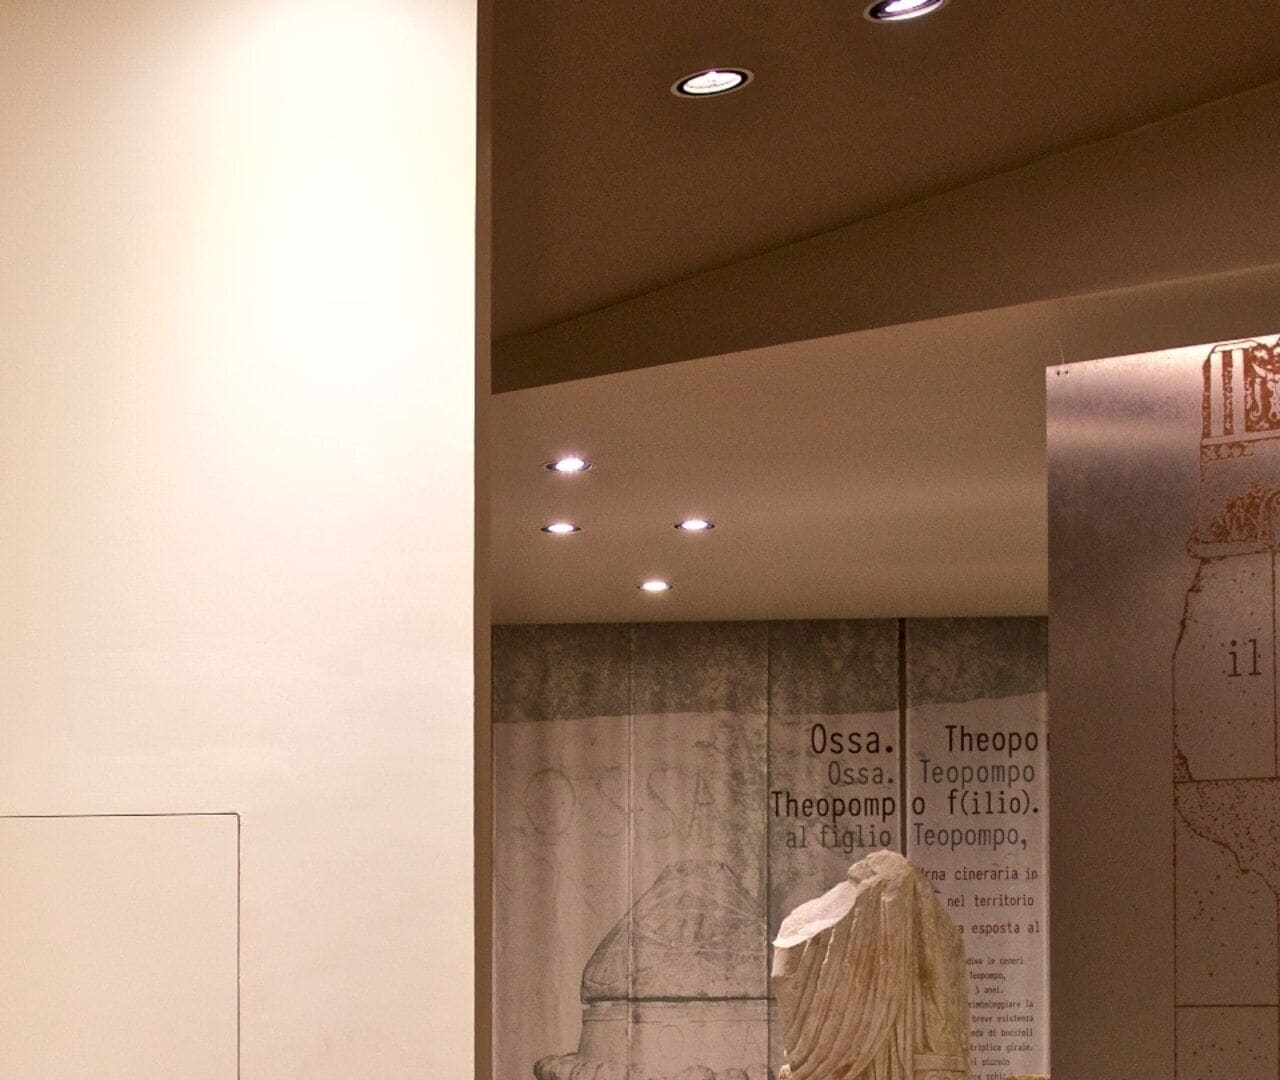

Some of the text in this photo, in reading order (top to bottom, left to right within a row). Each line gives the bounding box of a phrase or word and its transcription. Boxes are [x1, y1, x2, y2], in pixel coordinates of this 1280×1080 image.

[1228, 639, 1261, 677] il
[810, 723, 1051, 757] Ossa. Theopo
[828, 759, 1035, 789] Ossa. Teopompo
[947, 789, 1039, 816] f(ilio).
[786, 823, 1027, 854] al figlio Teopompo,
[954, 866, 1019, 881] cineraria
[1025, 867, 1039, 880] in
[947, 894, 1035, 907] nel territorio
[971, 922, 1020, 936] esposta
[1027, 921, 1040, 933] al
